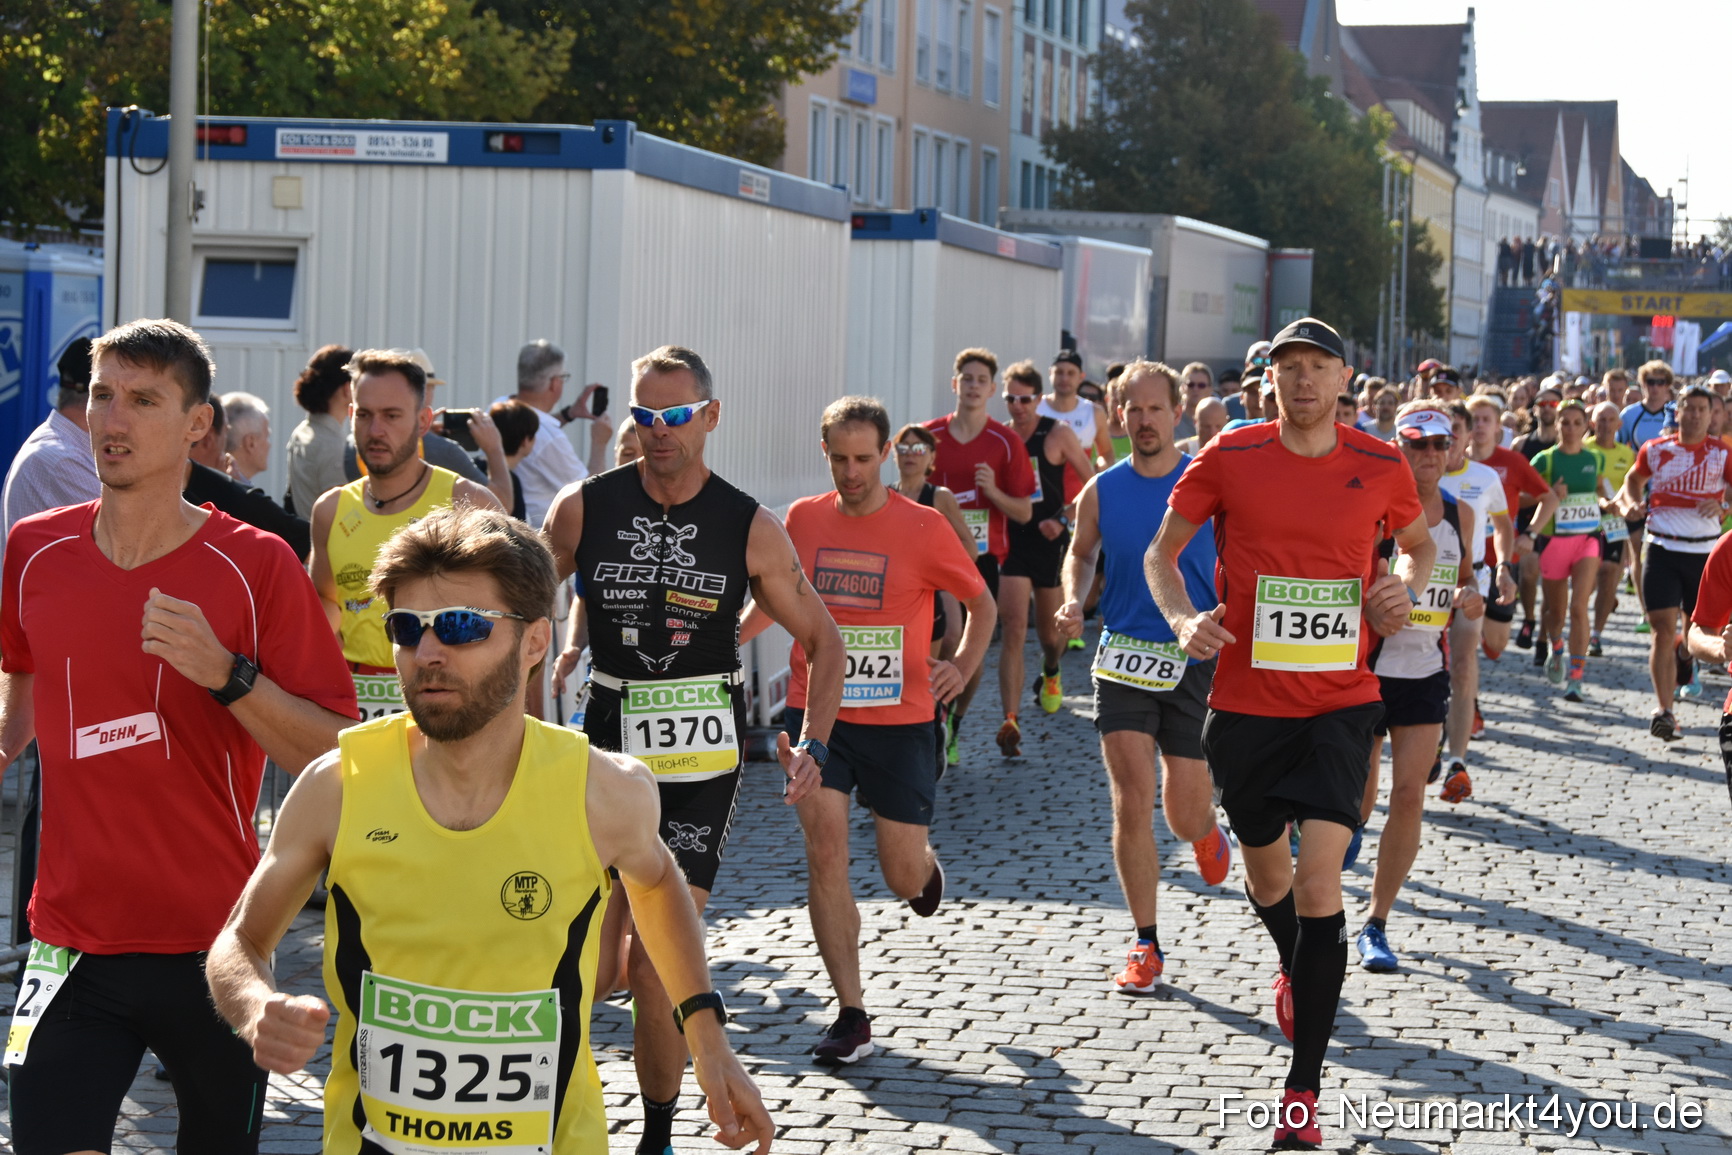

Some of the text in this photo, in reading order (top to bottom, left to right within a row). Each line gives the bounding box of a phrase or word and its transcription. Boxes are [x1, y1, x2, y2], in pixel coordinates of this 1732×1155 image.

[1620, 295, 1684, 312] START
[1560, 507, 1596, 521] 2704
[618, 531, 639, 540] Team
[593, 562, 727, 594] PIRATE
[817, 571, 880, 596] 0774600
[603, 589, 648, 600] uvex
[668, 592, 717, 610] PowerBar
[1265, 580, 1354, 605] BOCK
[665, 604, 711, 620] connex
[1268, 610, 1349, 640] 1364
[1114, 653, 1175, 679] 1078
[1107, 672, 1164, 687] CARSTEN
[629, 684, 724, 711] BOCK
[99, 724, 138, 745] DEHN
[635, 715, 723, 749] 1370
[644, 755, 699, 772] THOMAS
[372, 835, 392, 843] SPORTS
[515, 876, 538, 889] MTP
[374, 983, 544, 1038] BOCK
[379, 1042, 533, 1103] 1325
[539, 1056, 549, 1066] A
[385, 1111, 513, 1142] THOMAS
